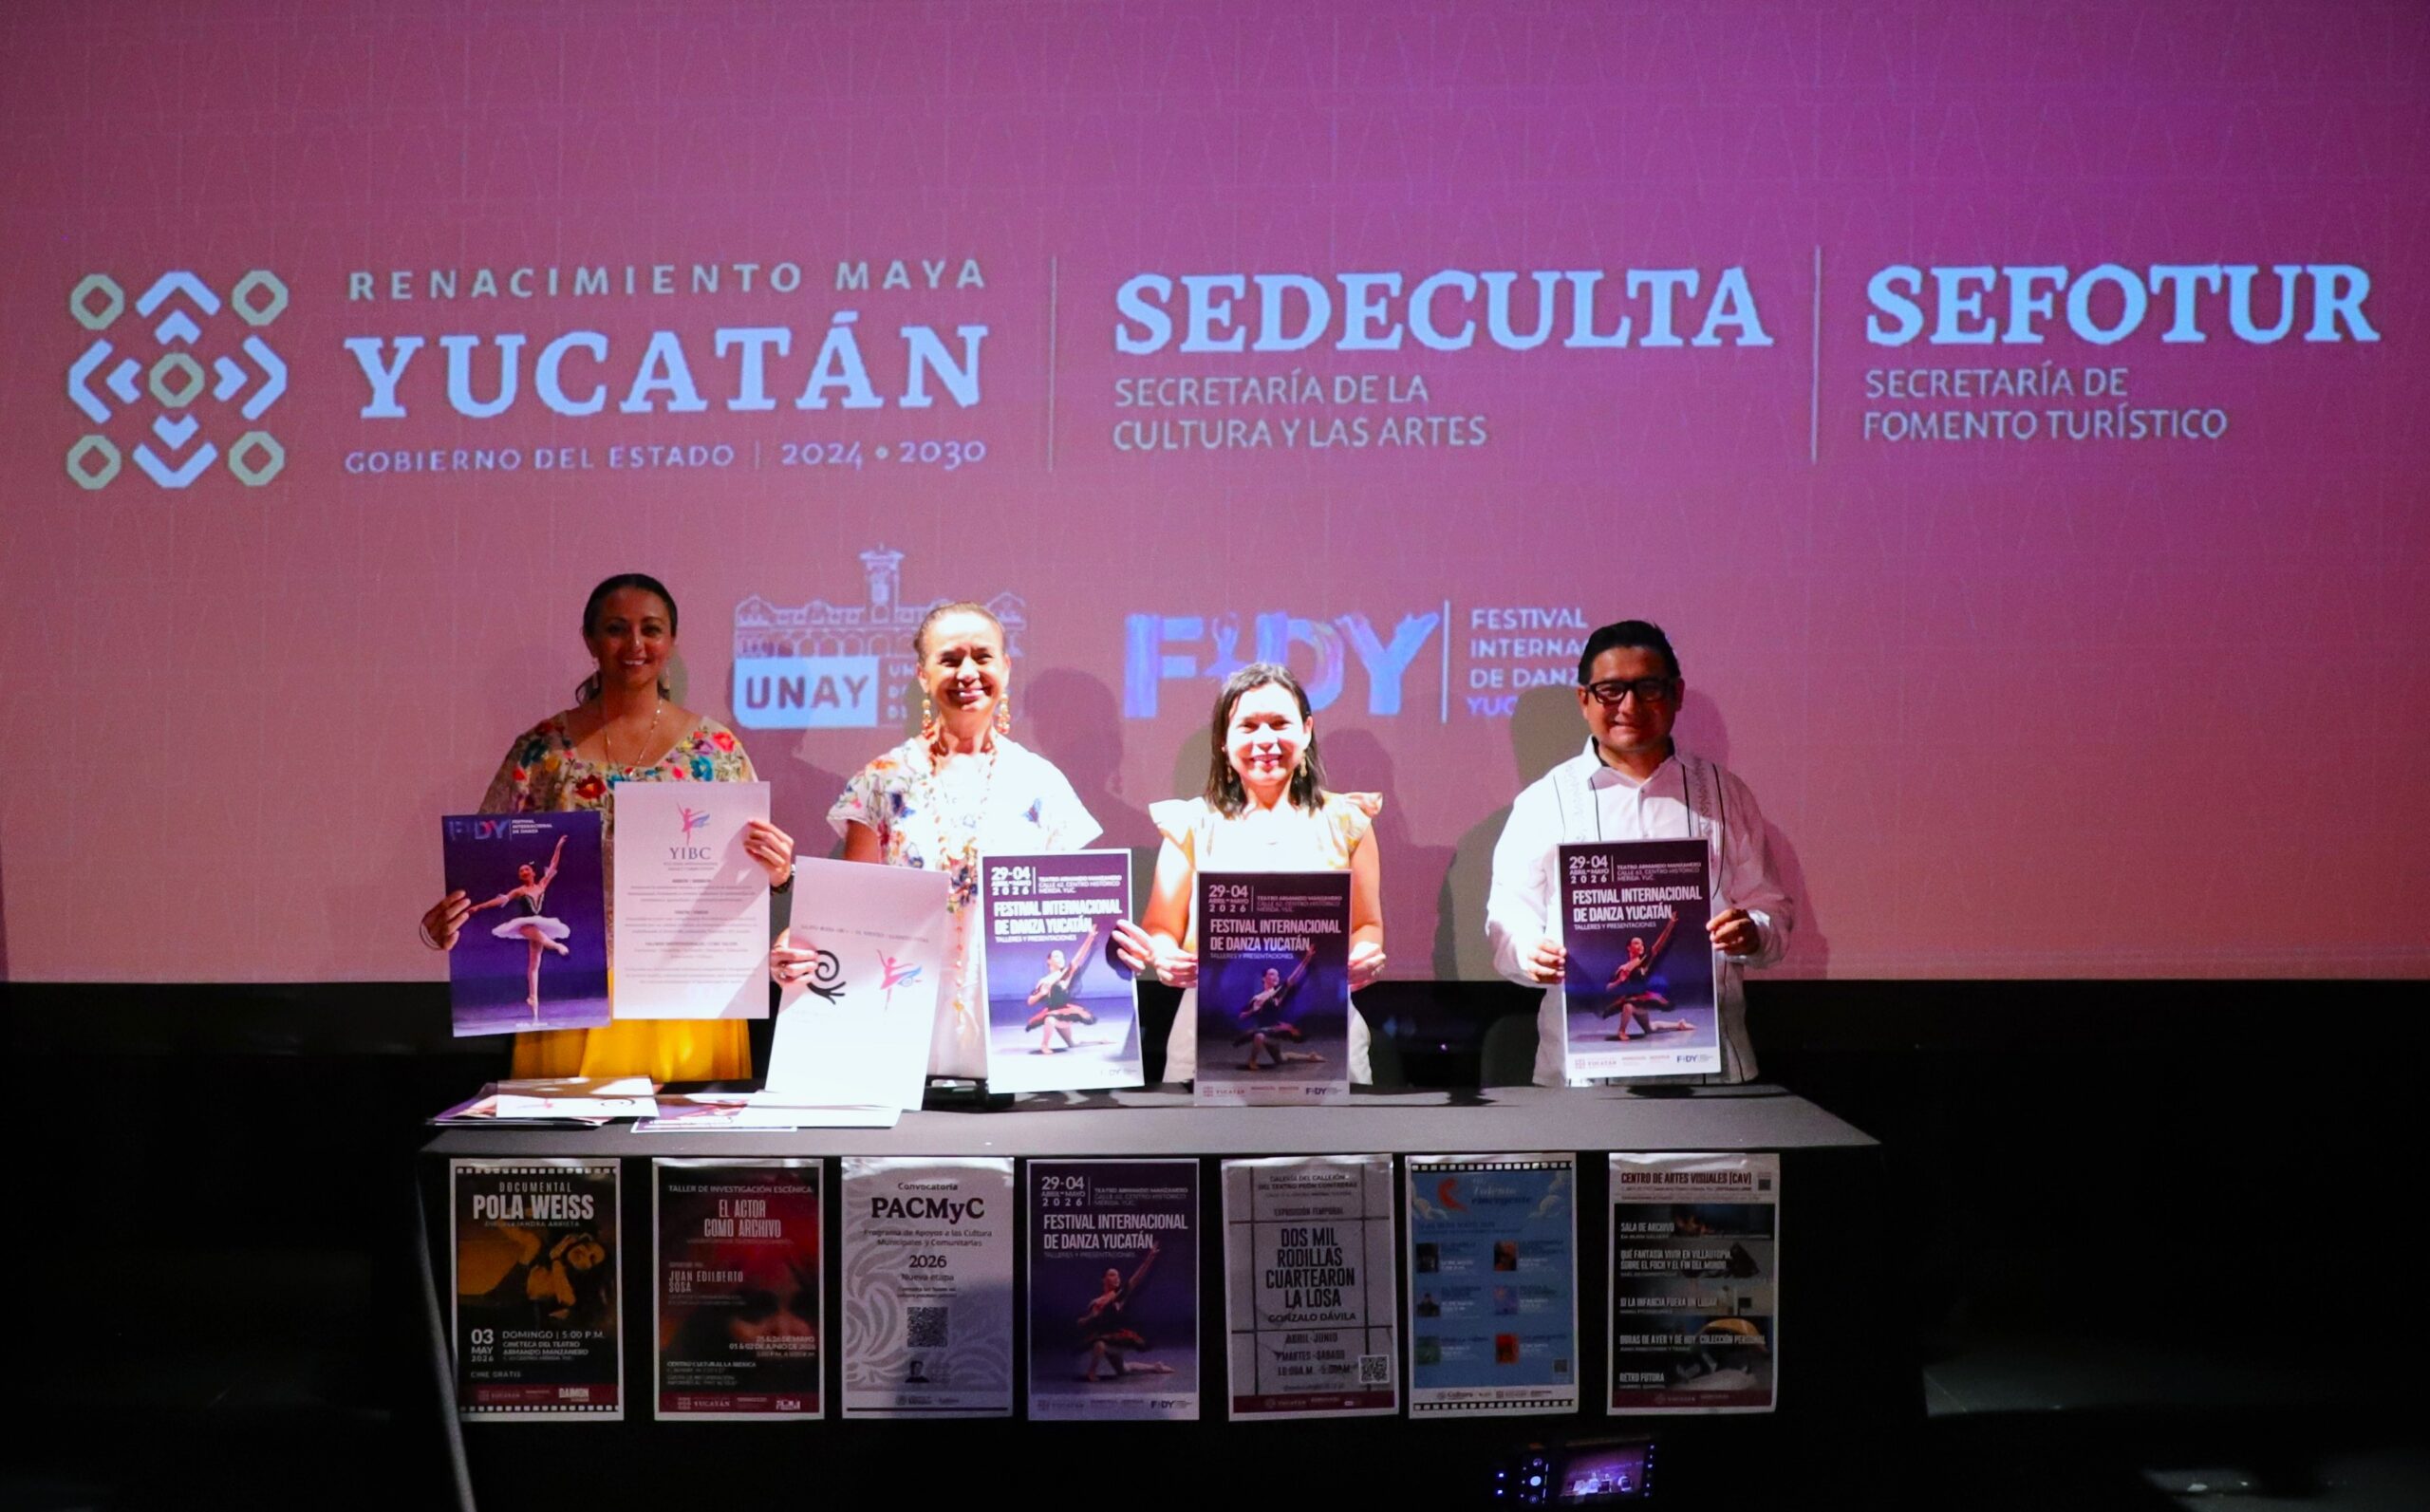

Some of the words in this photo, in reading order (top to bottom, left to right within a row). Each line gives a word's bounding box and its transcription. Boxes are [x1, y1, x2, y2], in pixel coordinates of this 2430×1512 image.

[347, 261, 802, 301] RENACIMIENTO
[835, 259, 985, 291] MAYA
[1114, 266, 1775, 355] SEDECULTA
[1866, 263, 2381, 346] SEFOTUR
[343, 310, 989, 419] YUCATÁN
[1113, 368, 1325, 408] SECRETARÍA
[1335, 375, 1379, 405] DE
[1389, 374, 1430, 403] LA
[1865, 361, 2075, 399] SECRETARÍA
[2084, 367, 2129, 397] DE
[1863, 409, 2038, 440] FOMENTO
[2047, 402, 2229, 439] TURÍSTICO
[1112, 419, 1273, 451] CULTURA
[1281, 419, 1301, 448] Y
[1310, 418, 1370, 448] LAS
[1378, 415, 1488, 447] ARTES
[345, 448, 522, 475] GOBIERNO
[534, 447, 593, 470] DEL
[608, 443, 735, 469] ESTADO
[781, 440, 863, 472] 2024
[899, 439, 986, 471] 2030
[1471, 607, 1589, 630] FESTIVAL
[1470, 637, 1587, 659] INTERNA
[1470, 666, 1505, 689] DE
[1512, 666, 1580, 688] DANZ
[745, 675, 869, 710] UNAY
[669, 847, 712, 860] YIBC
[1569, 855, 1609, 869] 29-04
[991, 867, 1031, 881] 29-04
[1571, 875, 1607, 884] 2026
[992, 887, 1029, 896] 2026
[1208, 885, 1249, 898] 29-04
[1572, 888, 1620, 905] FESTIVAL
[1621, 886, 1703, 904] INTERNACIONAL
[994, 901, 1041, 917] FESTIVAL
[1042, 898, 1123, 915] INTERNACIONAL
[1209, 904, 1246, 913] 2026
[1573, 907, 1588, 923] DE
[1589, 906, 1624, 922] DANZA
[1625, 902, 1673, 921] YUCATÁN
[994, 919, 1010, 935] DE
[1010, 919, 1046, 934] DANZA
[1045, 914, 1094, 934] YUCATÁN
[1210, 919, 1258, 934] FESTIVAL
[1260, 919, 1342, 934] INTERNACIONAL
[1210, 937, 1224, 951] DE
[1225, 936, 1262, 951] DANZA
[1262, 933, 1310, 951] YUCATÁN
[1041, 1176, 1085, 1190] 29-04
[1620, 1172, 1651, 1185] CENTRO
[1653, 1172, 1663, 1184] DE
[1665, 1172, 1689, 1184] ARTES
[1691, 1172, 1728, 1185] VISUALES
[499, 1182, 571, 1193] DOCUMENTAL
[668, 1185, 697, 1193] TALLER
[710, 1184, 773, 1193] INVESTIGACIÓN
[897, 1183, 959, 1191] Convocatoria
[473, 1194, 525, 1220] POLA
[531, 1194, 595, 1220] WEISS
[719, 1199, 730, 1218] EL
[734, 1199, 767, 1218] ACTOR
[1042, 1198, 1083, 1206] 2026
[871, 1197, 985, 1224] PACMyC
[703, 1218, 735, 1238] COMO
[738, 1219, 782, 1238] ARCHIVO
[1043, 1214, 1095, 1229] FESTIVAL
[1098, 1214, 1189, 1230] INTERNACIONAL
[1620, 1223, 1637, 1232] SALA
[1638, 1223, 1648, 1232] DE
[1648, 1223, 1675, 1232] ARCHIVO
[864, 1229, 902, 1238] Programa
[1043, 1234, 1059, 1249] DE
[1061, 1233, 1100, 1249] DANZA
[1102, 1230, 1154, 1249] YUCATÁN
[1281, 1227, 1309, 1247] DOS
[1313, 1227, 1338, 1247] MIL
[877, 1239, 923, 1247] Municipales
[908, 1255, 947, 1268] 2026
[1277, 1247, 1343, 1268] RODILLAS
[1641, 1260, 1649, 1270] EL
[1672, 1260, 1679, 1270] EL
[668, 1270, 693, 1282] JUAN
[697, 1270, 744, 1282] EDILBERTO
[1265, 1267, 1355, 1289] CUARTEARON
[668, 1281, 692, 1293] SOSA
[1285, 1289, 1302, 1309] LA
[1306, 1288, 1342, 1308] LOSA
[1627, 1297, 1636, 1307] LA
[1268, 1313, 1318, 1323] GONZALO
[1320, 1311, 1356, 1321] DÁVILA
[471, 1329, 494, 1345] 03
[502, 1331, 553, 1339] DOMINGO
[1285, 1334, 1309, 1344] ABRIL
[1313, 1332, 1338, 1343] JUNIO
[1641, 1335, 1651, 1345] DE
[1651, 1335, 1668, 1345] AYER
[471, 1346, 494, 1355] MAY
